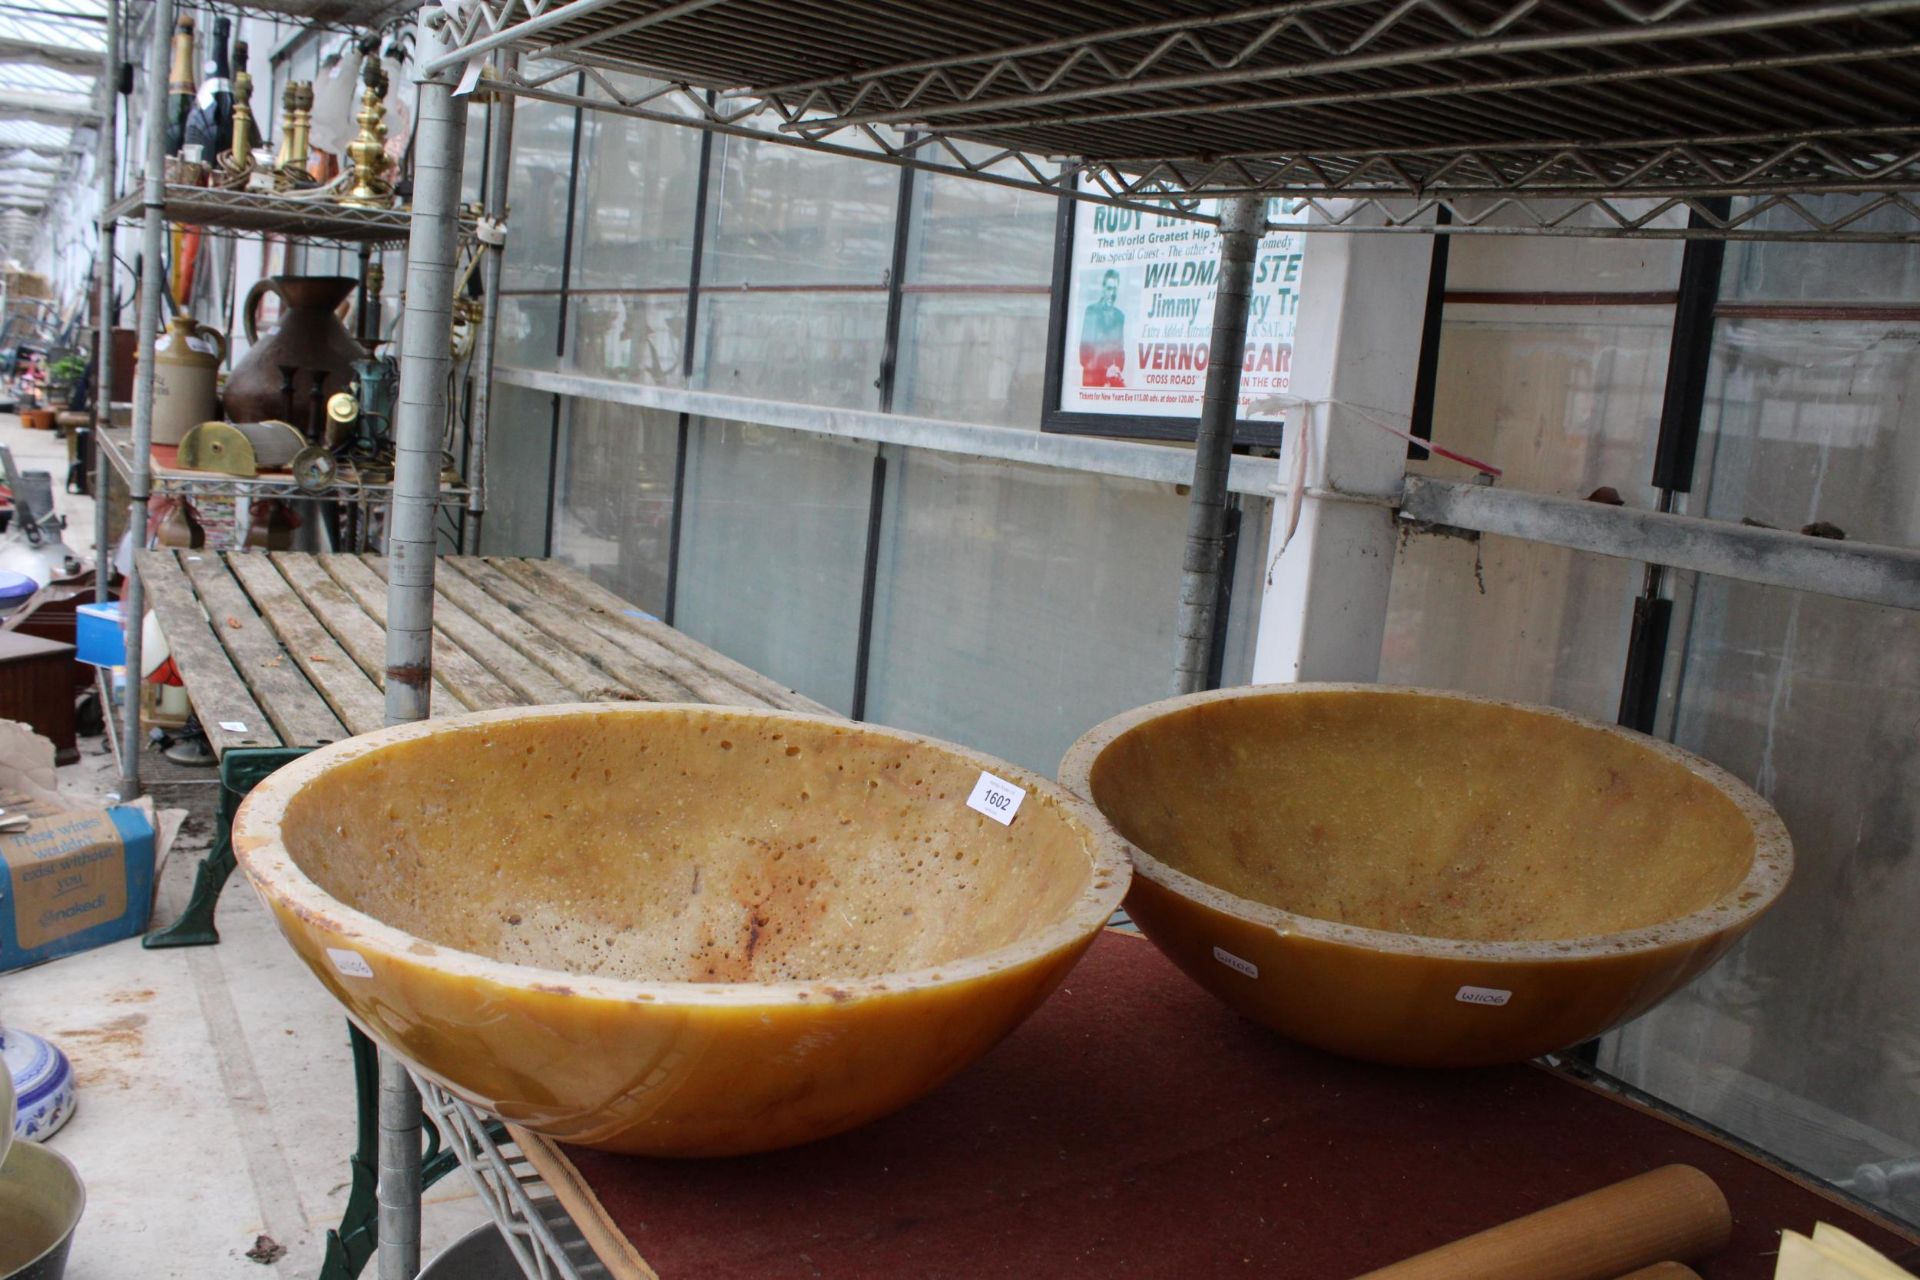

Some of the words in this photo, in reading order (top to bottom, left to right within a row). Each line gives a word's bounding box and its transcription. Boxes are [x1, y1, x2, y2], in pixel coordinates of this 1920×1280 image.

[1093, 201, 1146, 234] RUDY
[1090, 251, 1106, 263] Plus
[1107, 249, 1135, 264] Special
[1137, 247, 1160, 260] Guest
[1258, 235, 1293, 251] omedy
[1097, 237, 1115, 248] The
[1117, 234, 1146, 245] World
[1148, 230, 1189, 244] Greatest
[1192, 228, 1210, 242] Hip
[1147, 292, 1200, 325] Jimmy
[1252, 377, 1269, 388] THE
[985, 789, 1011, 811] 1602
